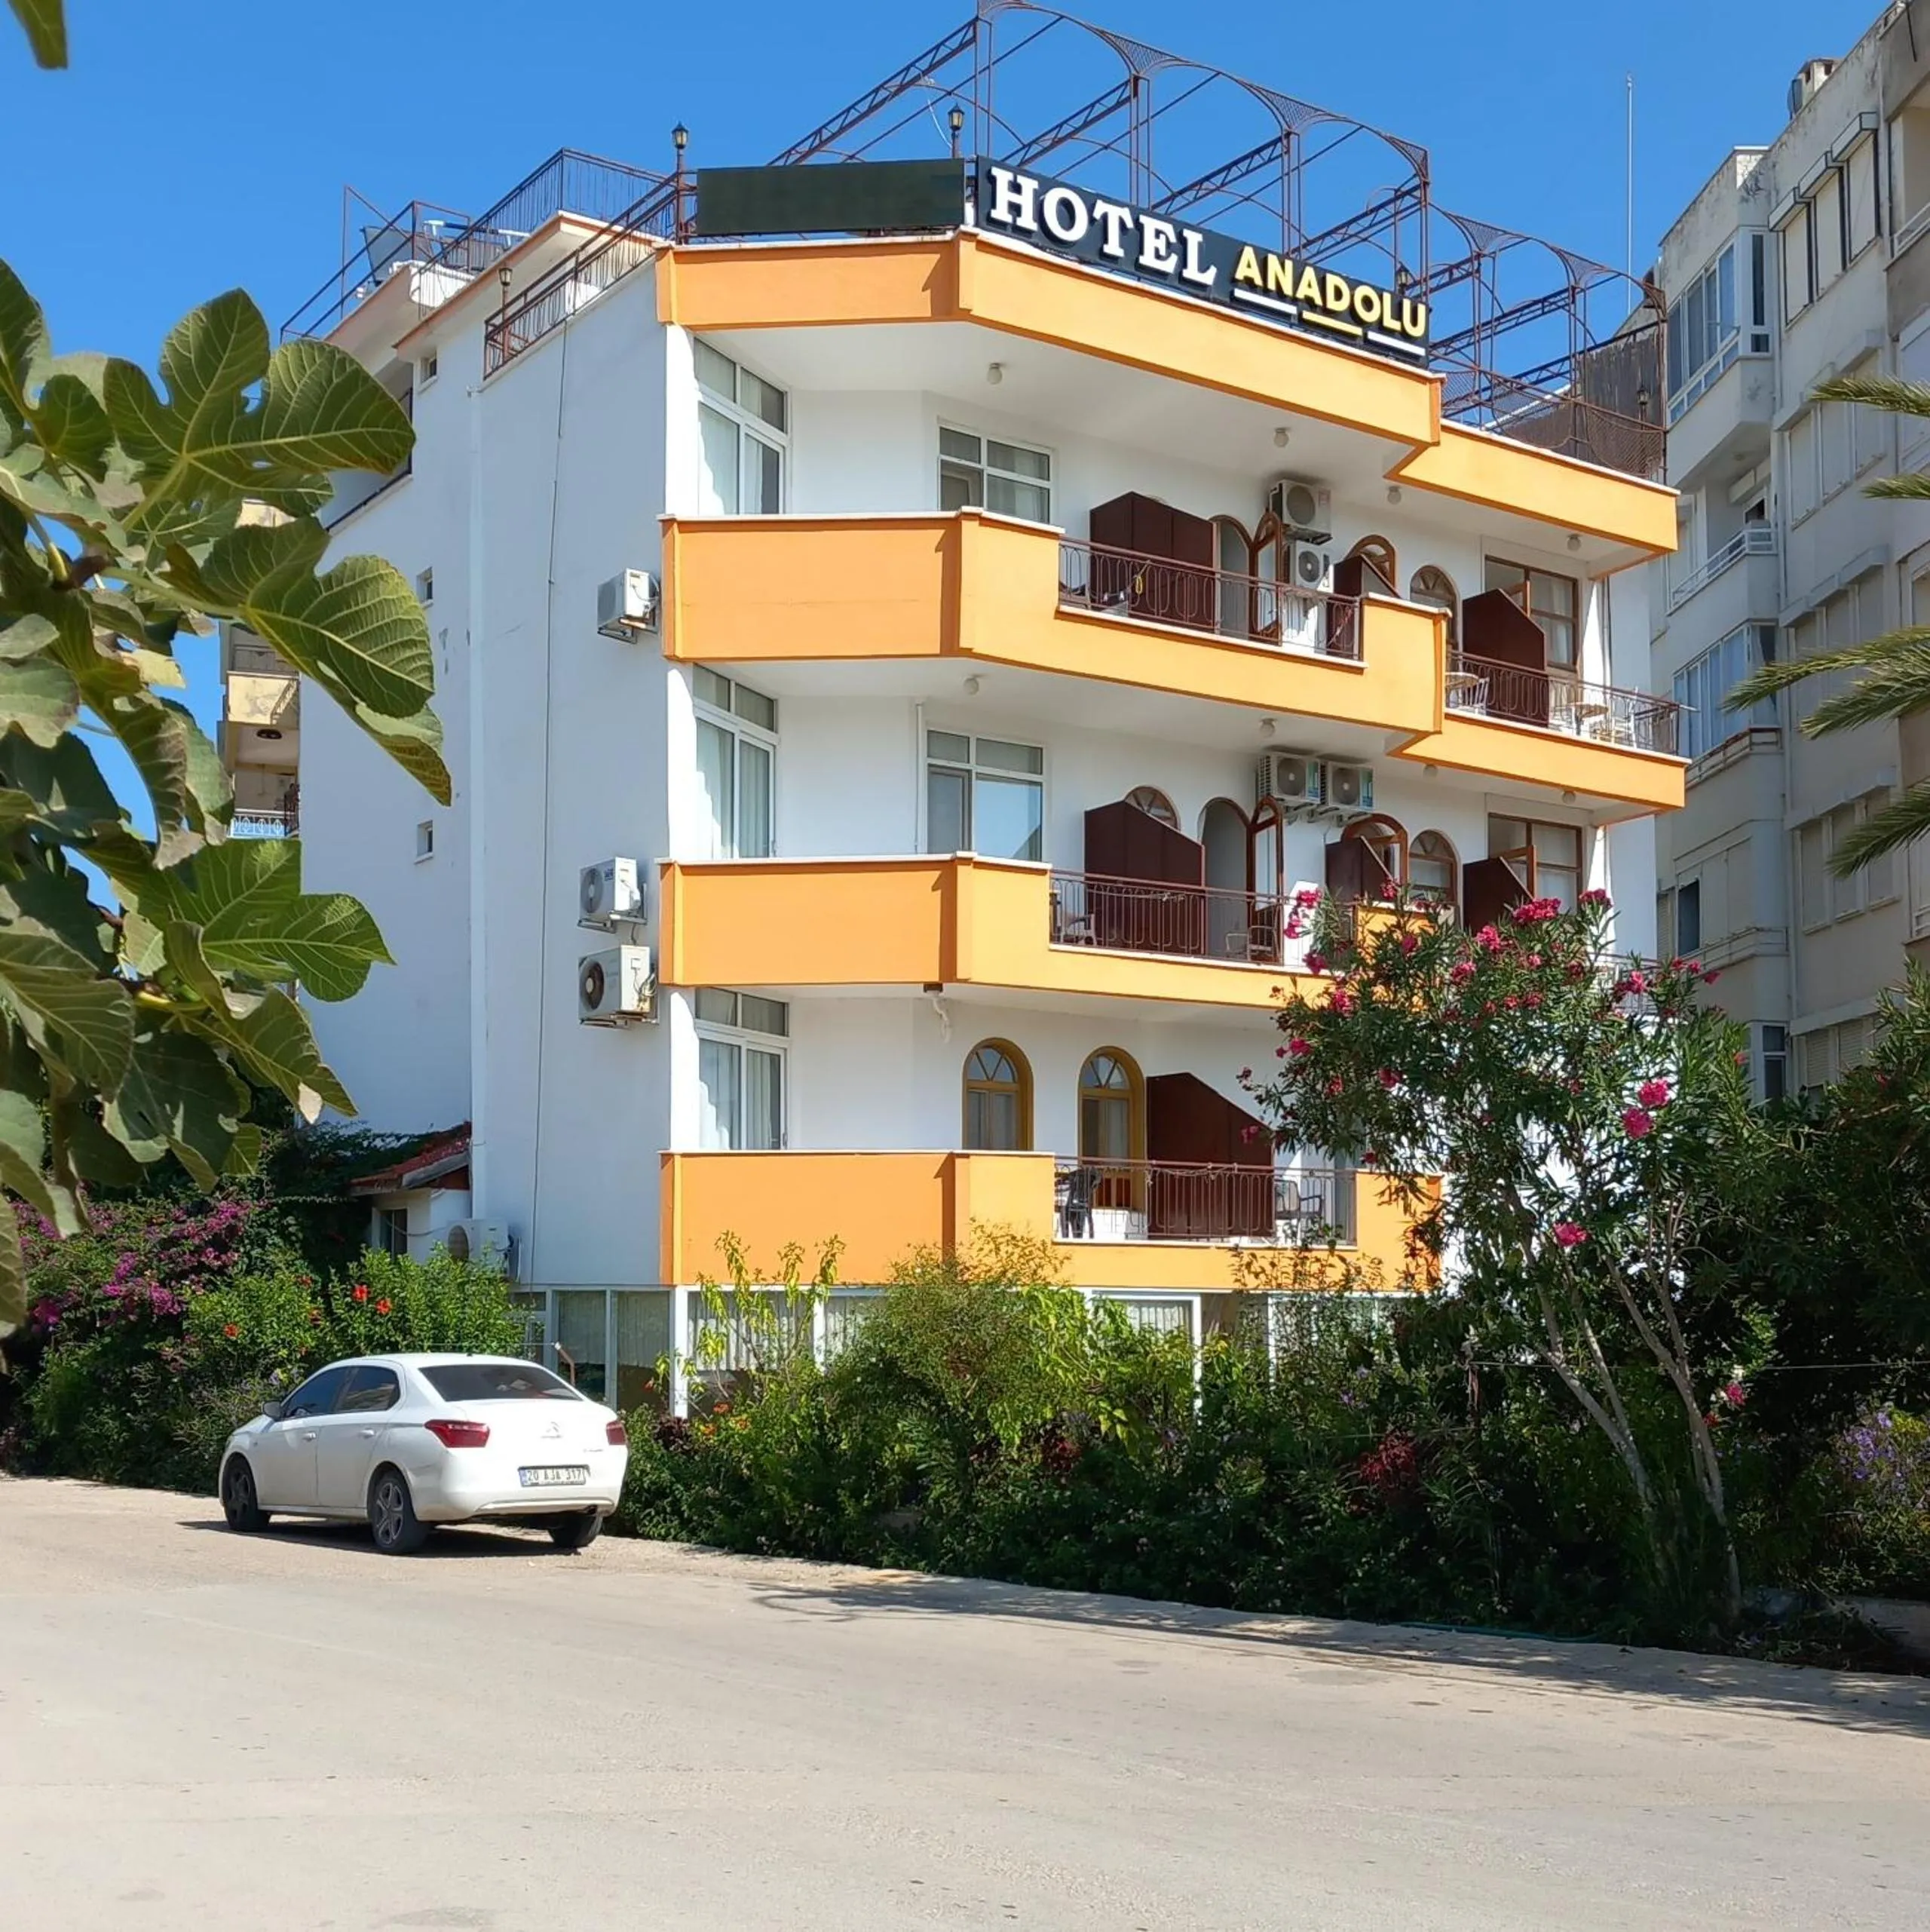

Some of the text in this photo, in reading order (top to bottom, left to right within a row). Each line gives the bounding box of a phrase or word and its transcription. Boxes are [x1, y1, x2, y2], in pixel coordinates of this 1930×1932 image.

[990, 166, 1426, 338] HOTEL ANADOLU
[527, 1470, 539, 1480] 20
